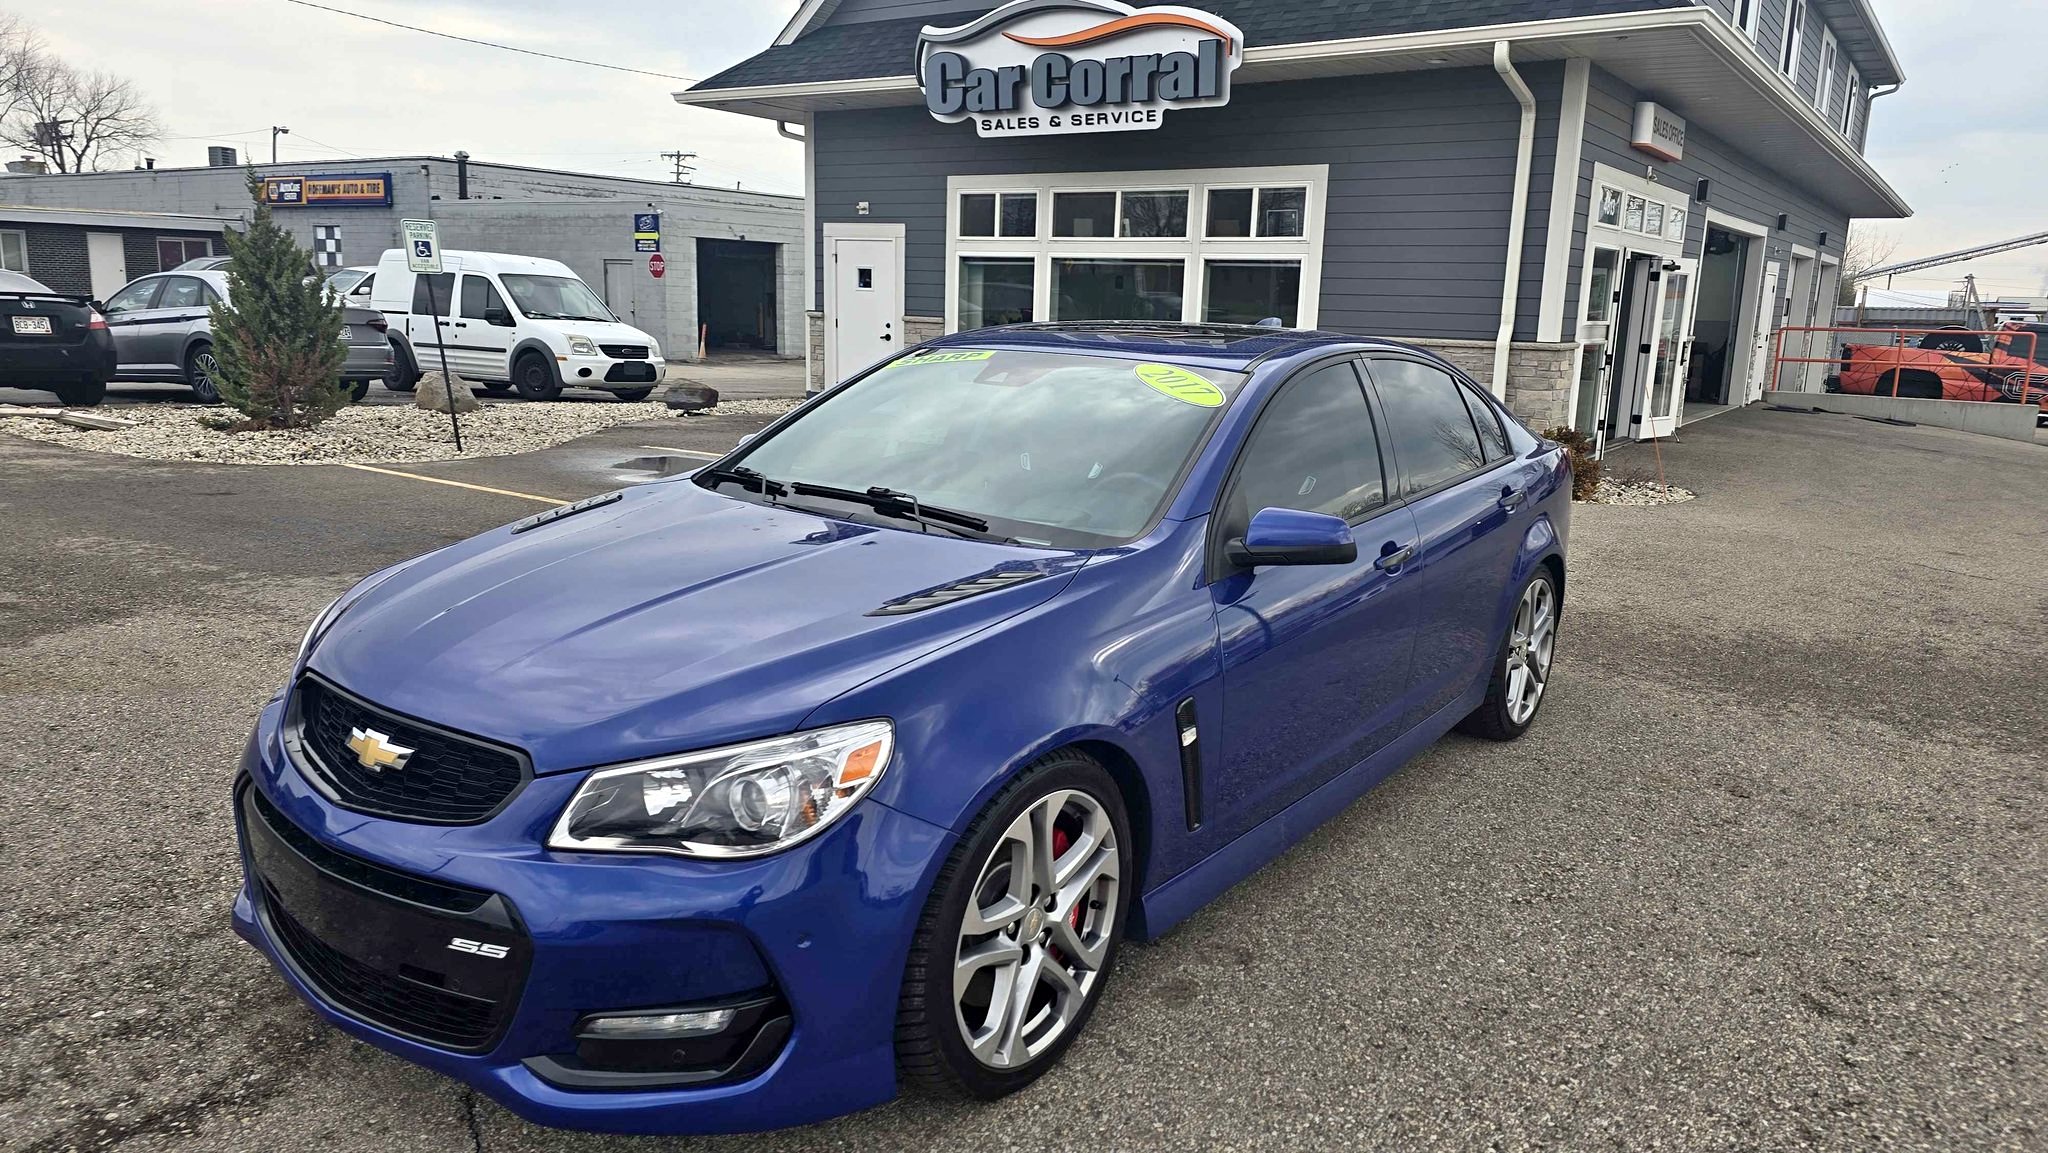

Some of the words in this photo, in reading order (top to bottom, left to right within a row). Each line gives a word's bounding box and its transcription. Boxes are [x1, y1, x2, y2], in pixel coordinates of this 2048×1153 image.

[925, 51, 1025, 115] Car
[1031, 39, 1221, 109] Corral
[981, 116, 1040, 131] SALES
[1049, 115, 1062, 127] &
[1070, 109, 1157, 127] SERVICE
[1653, 116, 1668, 139] SALES
[1668, 124, 1683, 147] OFFICE
[342, 184, 359, 194] AUTO
[366, 183, 380, 193] TIRE
[405, 222, 434, 232] RESERVED
[649, 262, 664, 271] STOP
[895, 352, 985, 366] SHARP
[1142, 366, 1216, 397] 2017
[446, 937, 512, 959] SS
